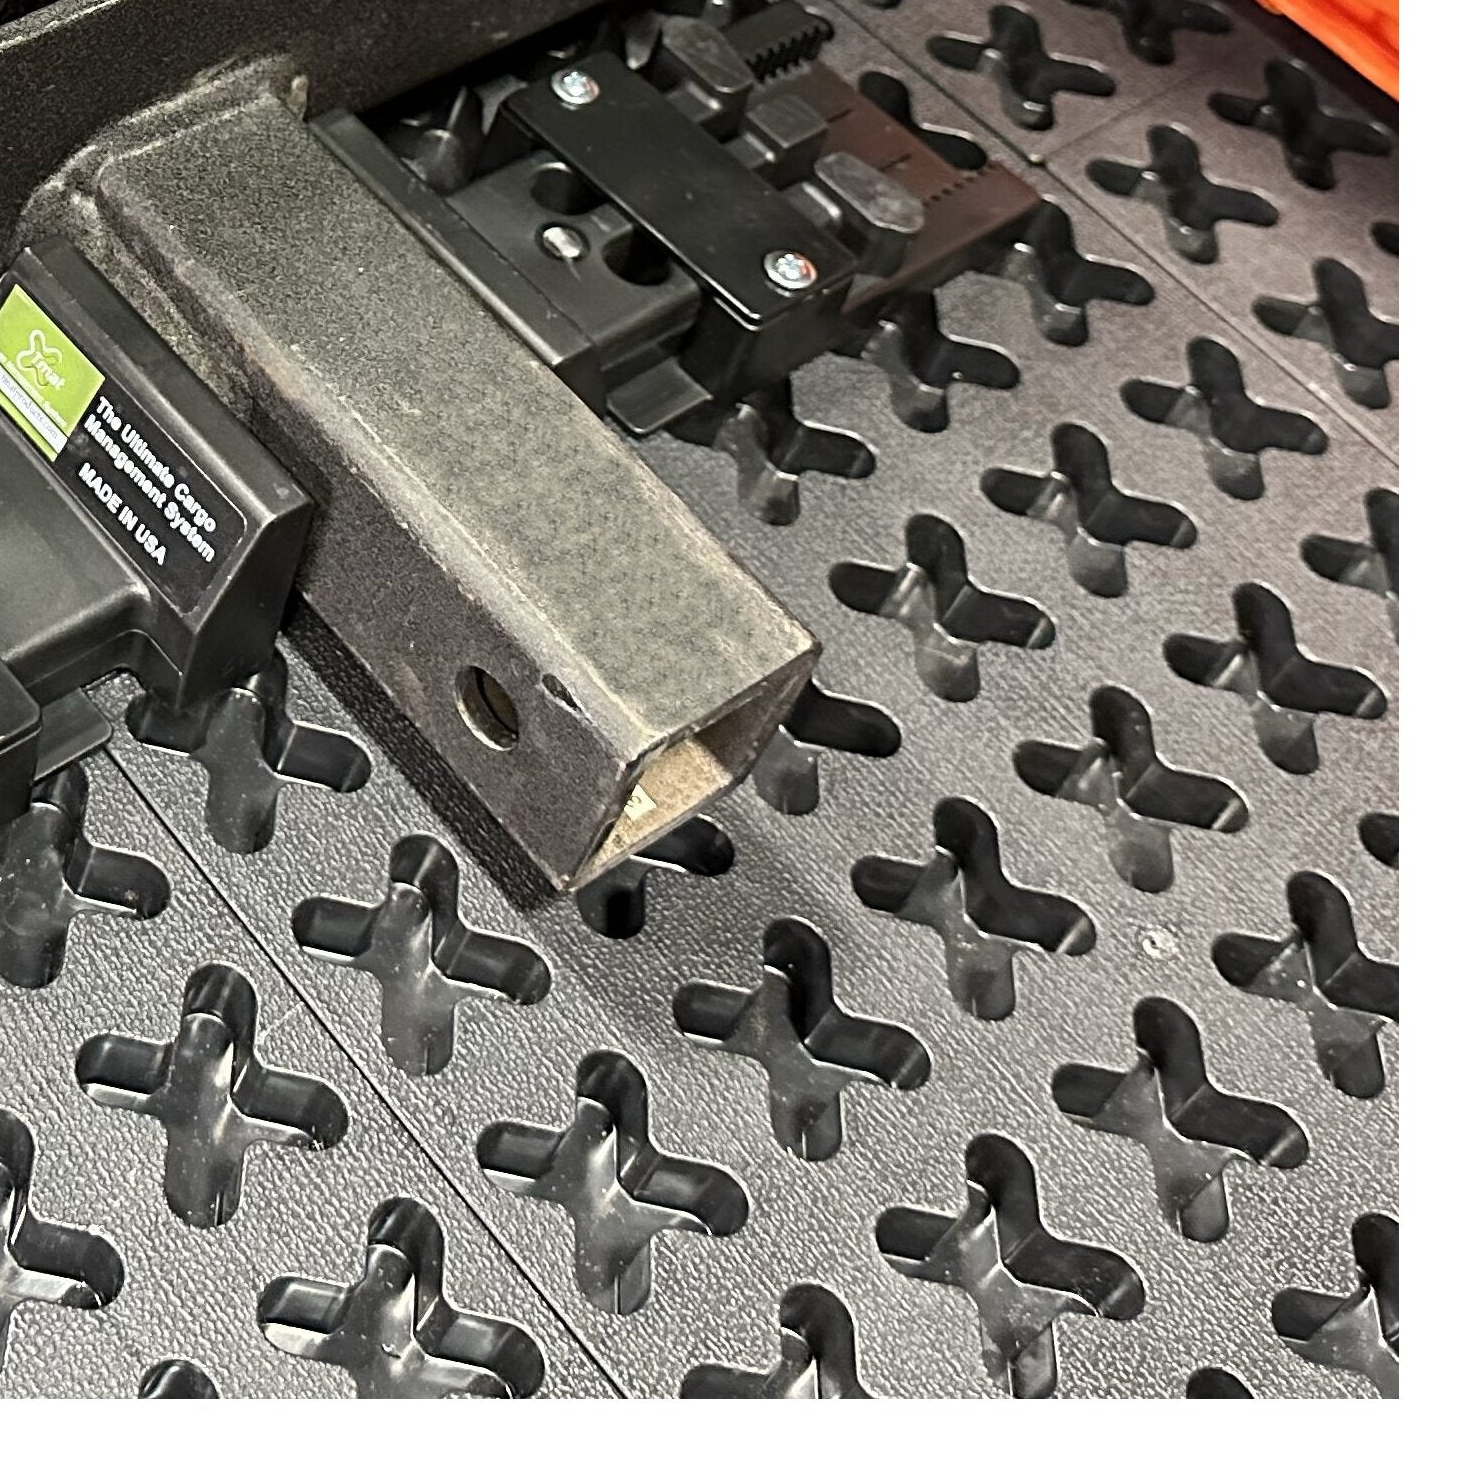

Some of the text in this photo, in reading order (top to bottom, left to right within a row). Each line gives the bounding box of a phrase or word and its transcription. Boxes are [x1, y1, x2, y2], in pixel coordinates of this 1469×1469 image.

[78, 462, 165, 565] MADE IN USA
[84, 414, 214, 561] Management System
[96, 396, 215, 531] The Ultimate Cargo
